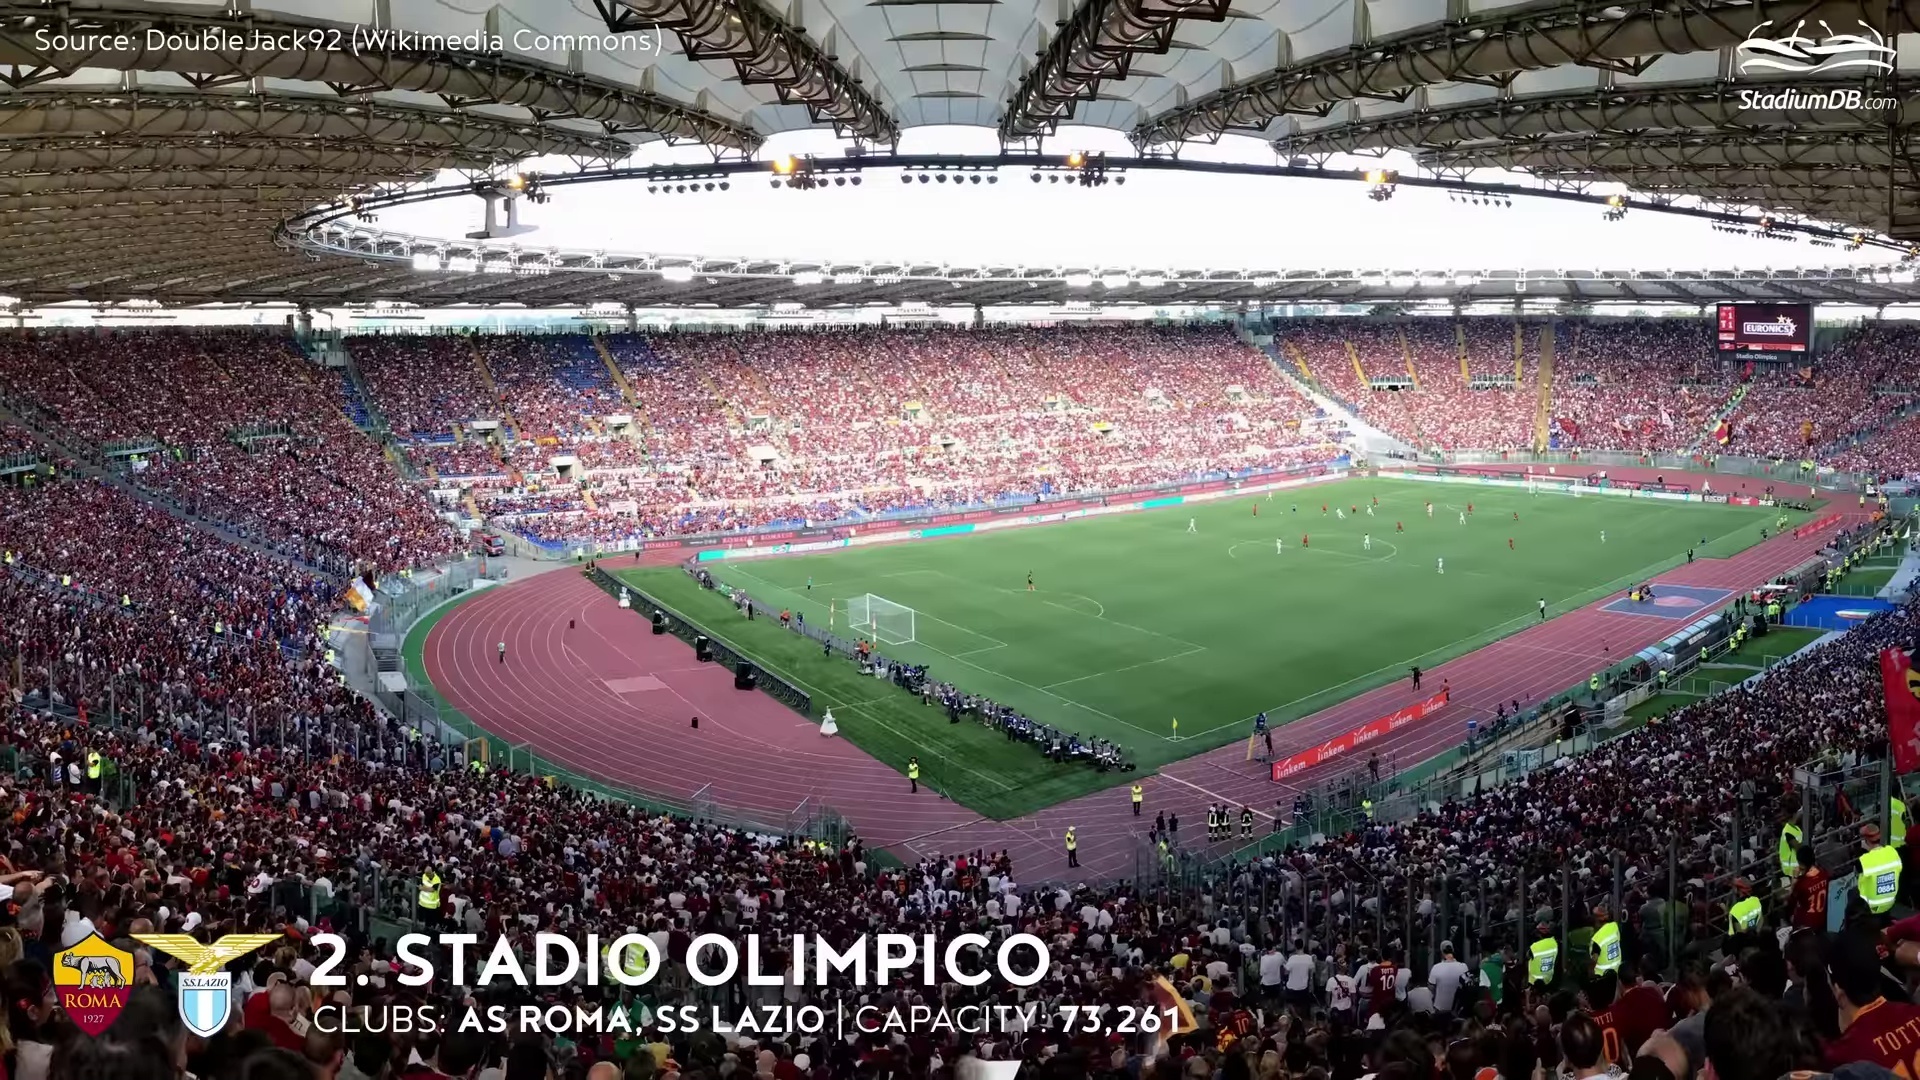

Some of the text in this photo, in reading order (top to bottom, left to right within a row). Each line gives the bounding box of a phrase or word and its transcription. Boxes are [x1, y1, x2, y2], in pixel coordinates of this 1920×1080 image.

[1746, 323, 1790, 333] EURONICS
[1422, 699, 1445, 715] linkem
[1389, 712, 1413, 729] linkem
[1353, 726, 1379, 745] linkem
[1317, 742, 1345, 761] linkem
[1277, 758, 1306, 779] linkem
[1807, 889, 1827, 913] 10
[1380, 974, 1395, 991] 10
